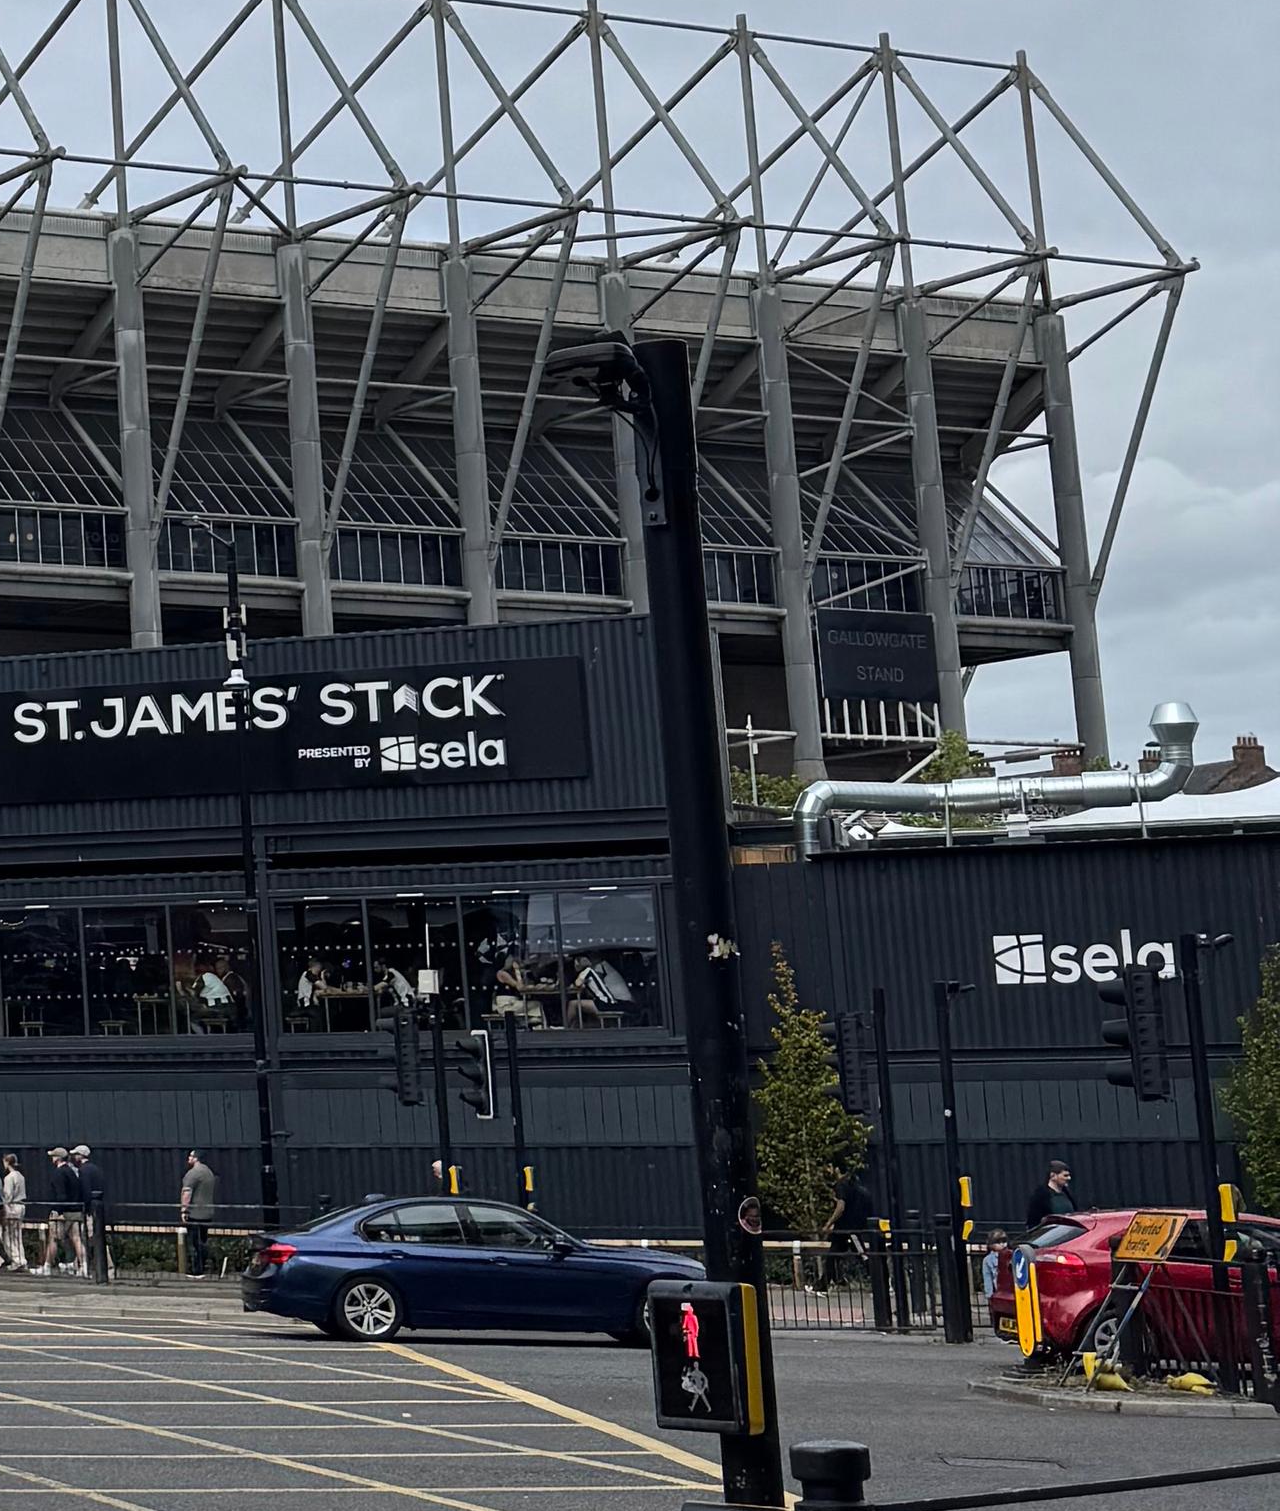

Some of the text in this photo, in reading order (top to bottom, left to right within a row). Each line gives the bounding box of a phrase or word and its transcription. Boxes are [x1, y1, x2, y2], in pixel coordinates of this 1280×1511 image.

[827, 629, 928, 649] GALLOWGATE
[856, 665, 904, 682] STAND
[298, 745, 371, 758] PRESENTED
[418, 731, 506, 770] sela
[354, 758, 371, 768] BY
[1050, 928, 1176, 984] sela
